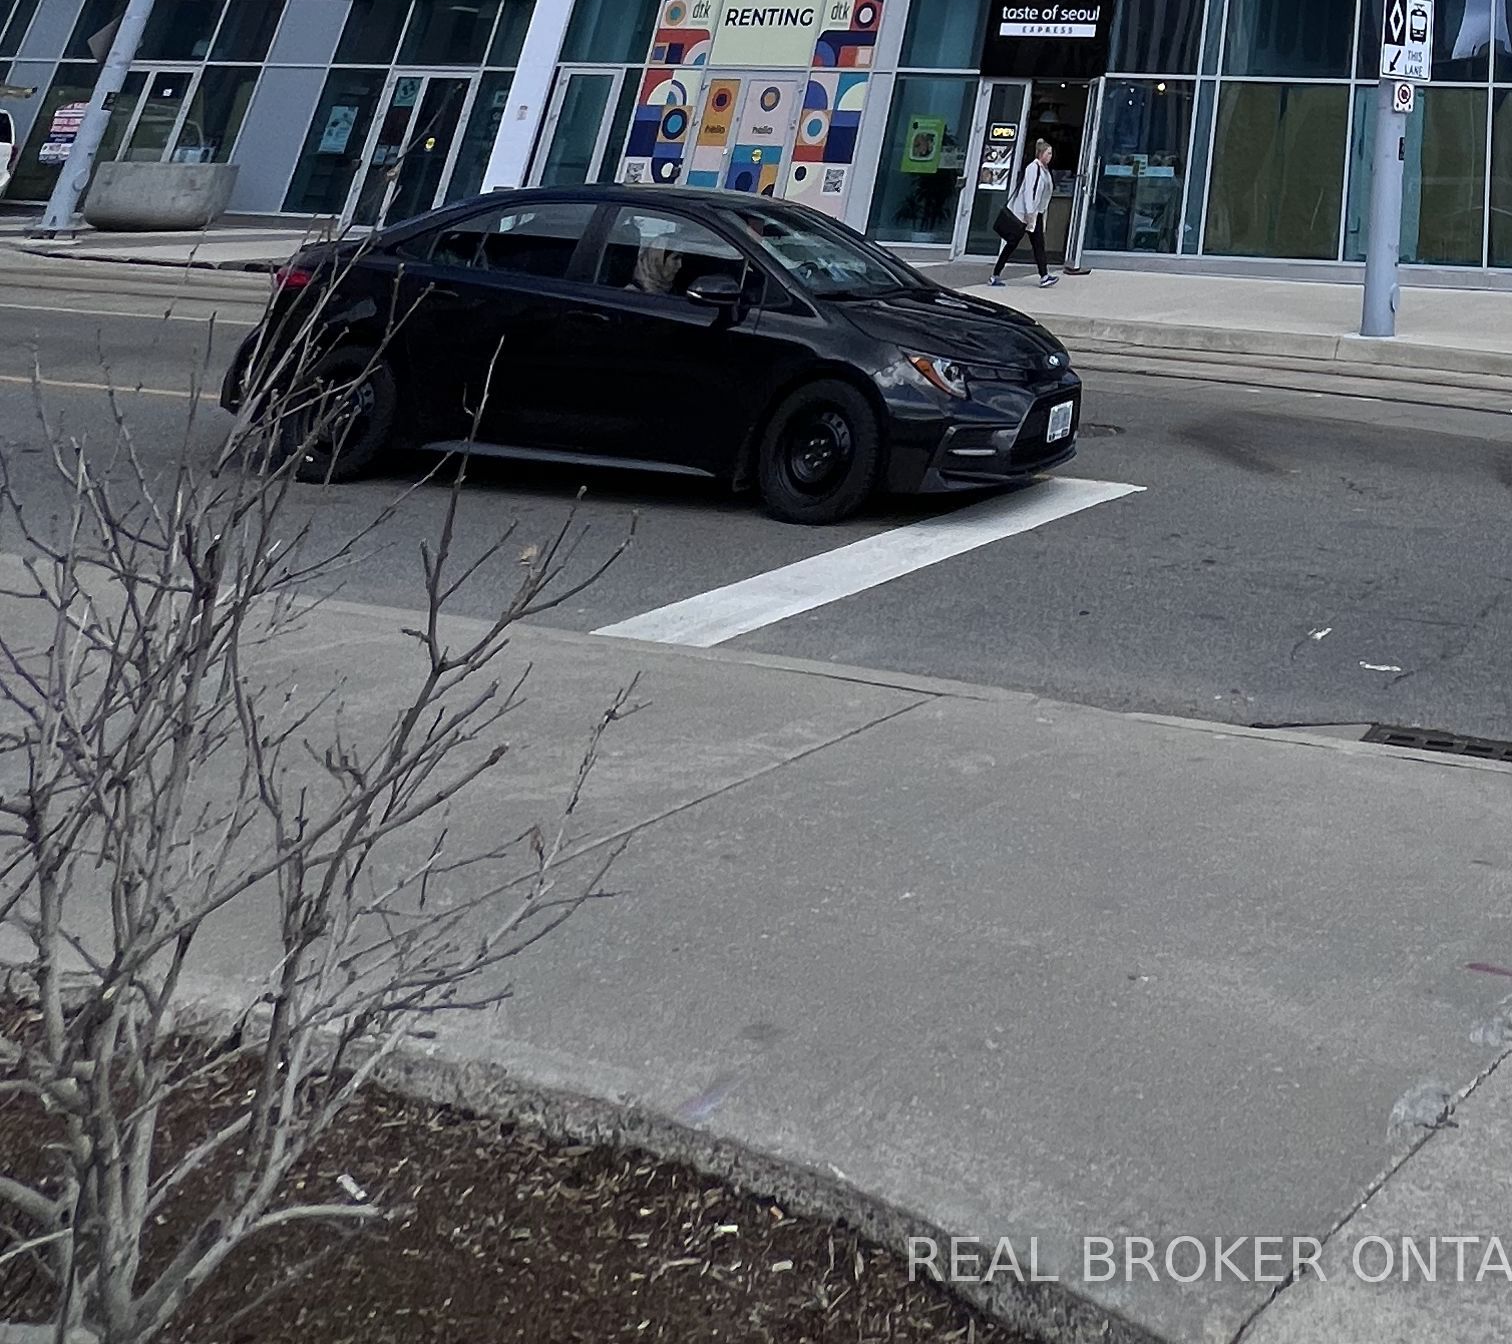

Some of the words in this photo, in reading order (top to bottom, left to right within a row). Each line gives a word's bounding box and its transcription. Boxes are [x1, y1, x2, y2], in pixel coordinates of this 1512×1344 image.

[725, 8, 814, 27] RENTING
[831, 1, 850, 20] dtk
[1002, 5, 1039, 20] taste
[1041, 4, 1060, 20] of
[1060, 5, 1101, 21] seoul
[1022, 25, 1073, 35] EXPRESS
[1407, 49, 1423, 63] THIS
[1404, 64, 1424, 77] LANE
[993, 127, 1015, 137] OPEN
